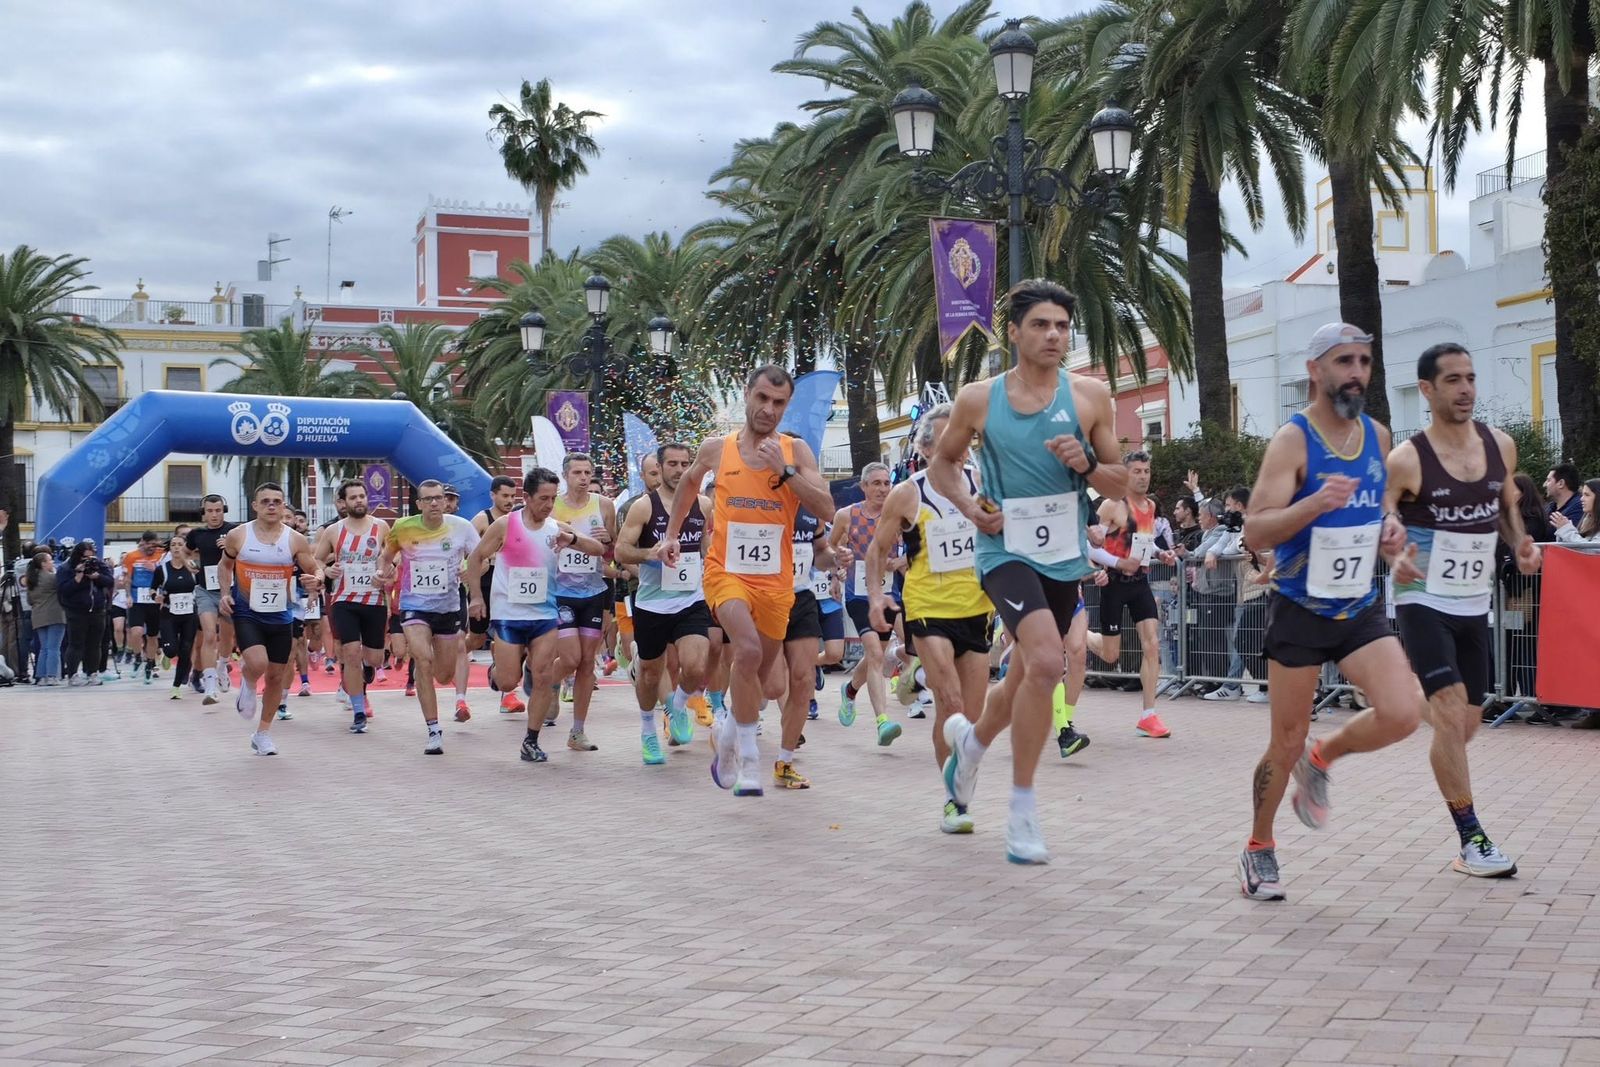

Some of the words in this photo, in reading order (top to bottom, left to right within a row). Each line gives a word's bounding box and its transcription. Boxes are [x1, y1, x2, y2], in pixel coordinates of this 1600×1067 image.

[297, 416, 350, 425] DIPUTACIÓN
[297, 426, 349, 434] PROVINCIAL
[1036, 525, 1050, 547] 9
[939, 536, 975, 558] 154
[566, 553, 590, 564] 188
[737, 545, 771, 562] 143
[1333, 557, 1362, 580] 97
[1442, 559, 1484, 580] 219
[350, 575, 371, 585] 142
[416, 575, 440, 586] 216
[678, 569, 687, 581] 6
[520, 583, 537, 594] 50
[261, 593, 278, 604] 57
